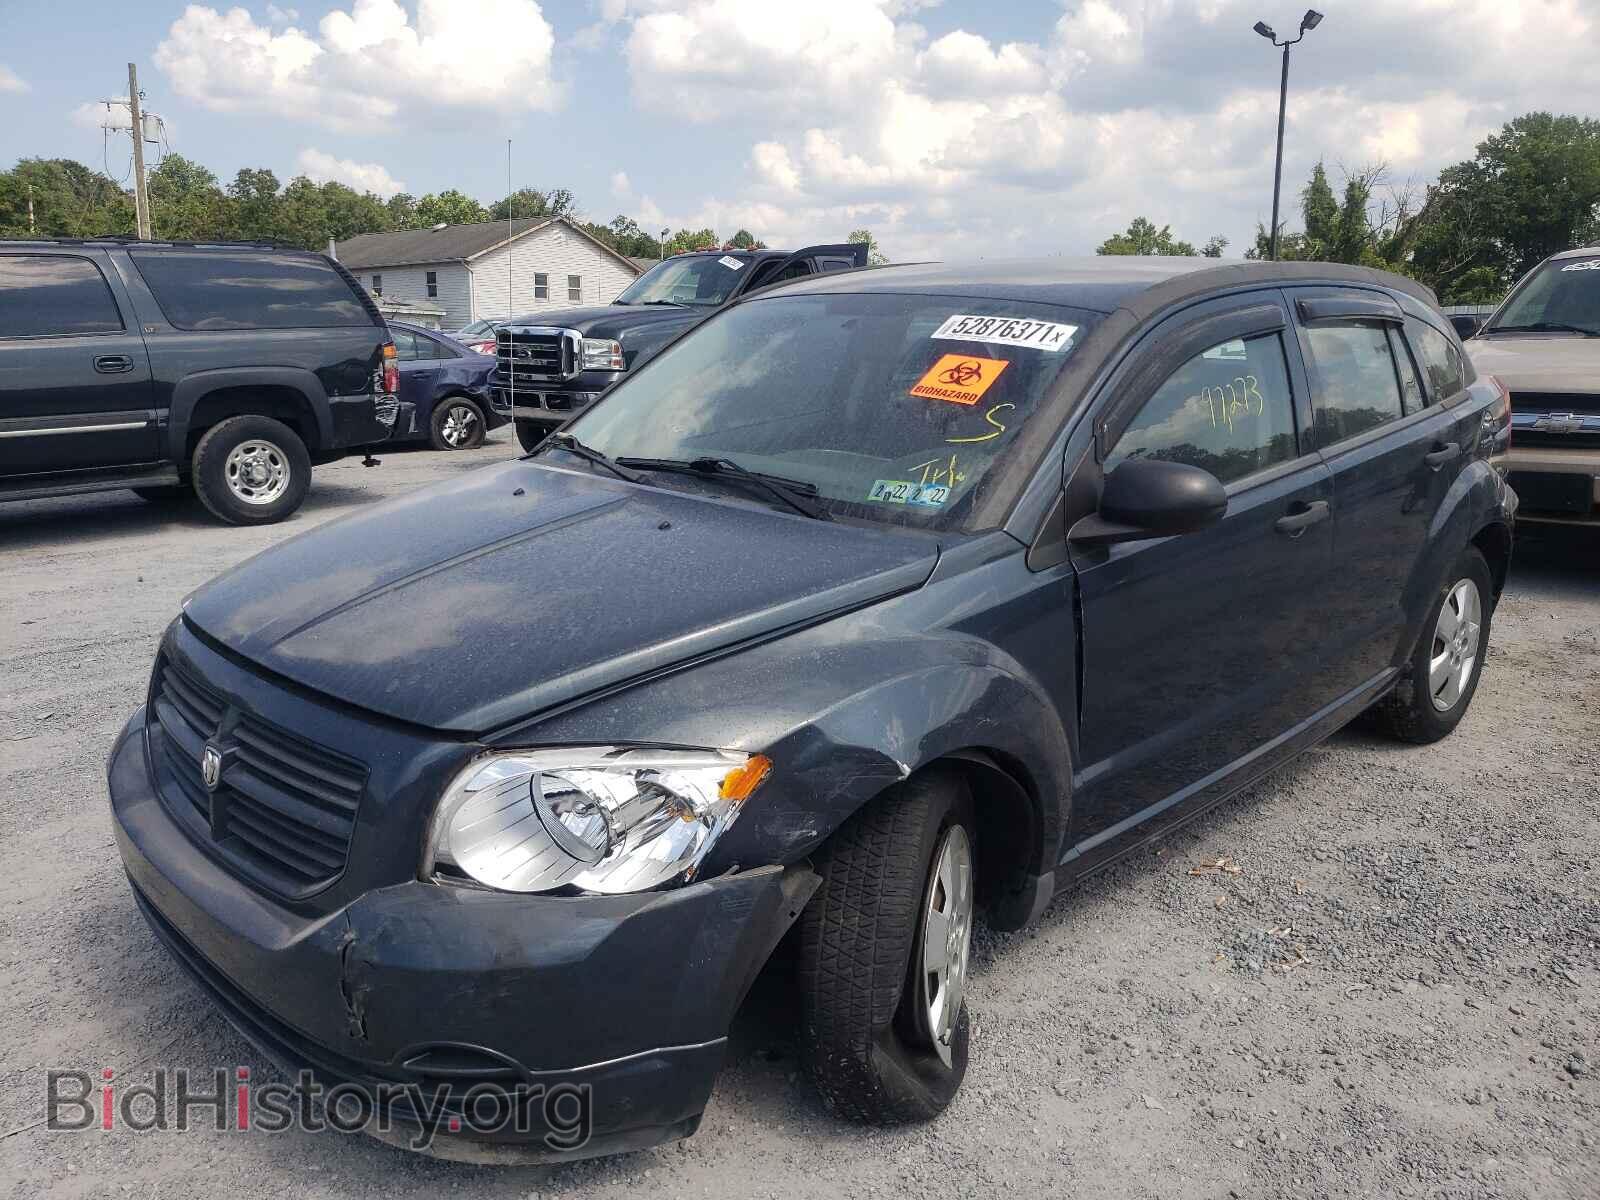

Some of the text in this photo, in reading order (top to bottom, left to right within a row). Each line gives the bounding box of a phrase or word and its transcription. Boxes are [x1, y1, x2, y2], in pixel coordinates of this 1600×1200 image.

[951, 316, 1057, 343] 52876371
[913, 384, 979, 402] BIOHAZARD
[892, 484, 908, 499] 22
[930, 487, 946, 503] 22
